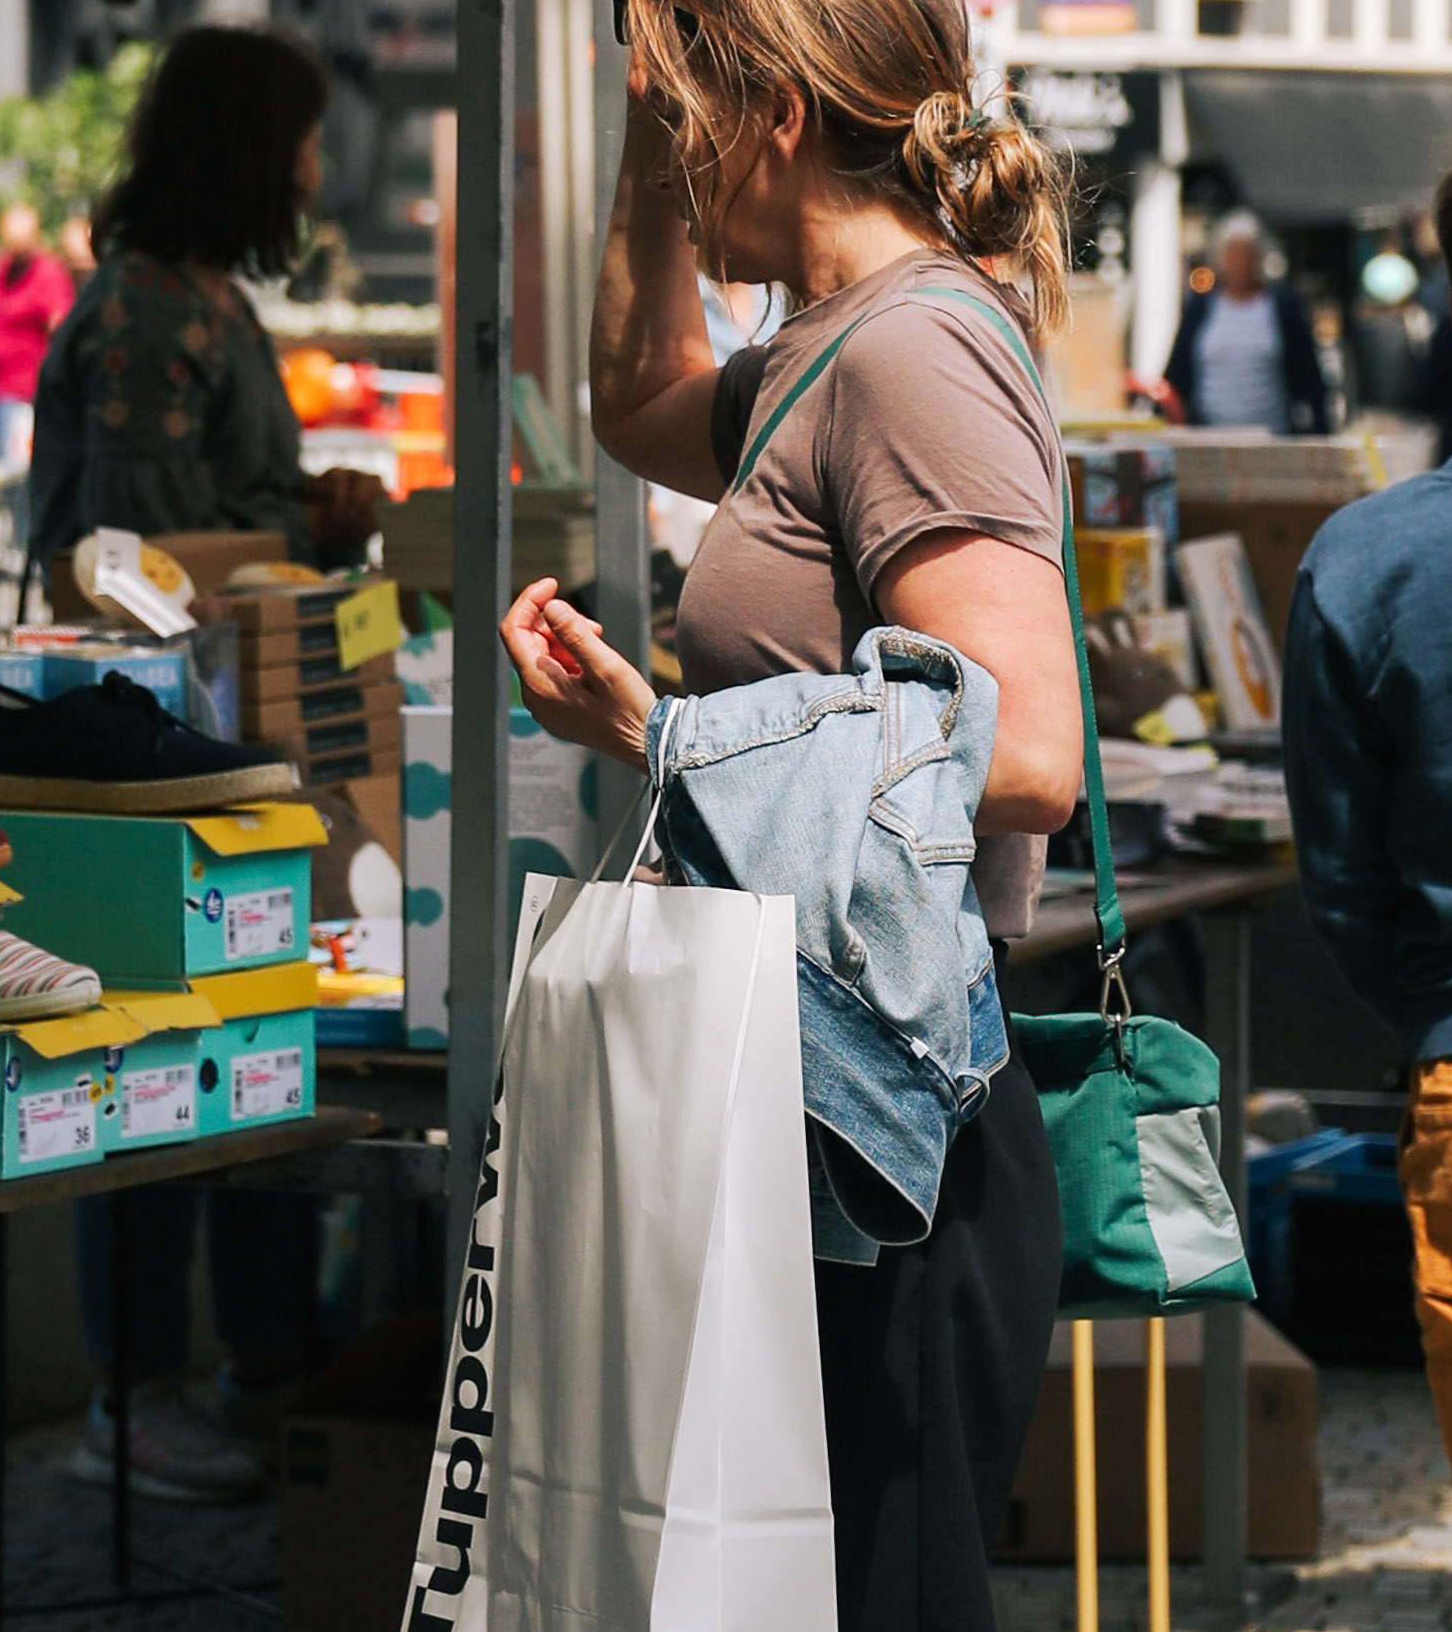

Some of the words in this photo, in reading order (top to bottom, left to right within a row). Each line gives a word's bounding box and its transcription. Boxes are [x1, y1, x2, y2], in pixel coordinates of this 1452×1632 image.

[279, 928, 293, 944] 45
[285, 1089, 300, 1105] 45
[176, 1105, 189, 1120] 44
[75, 1125, 91, 1145] 36
